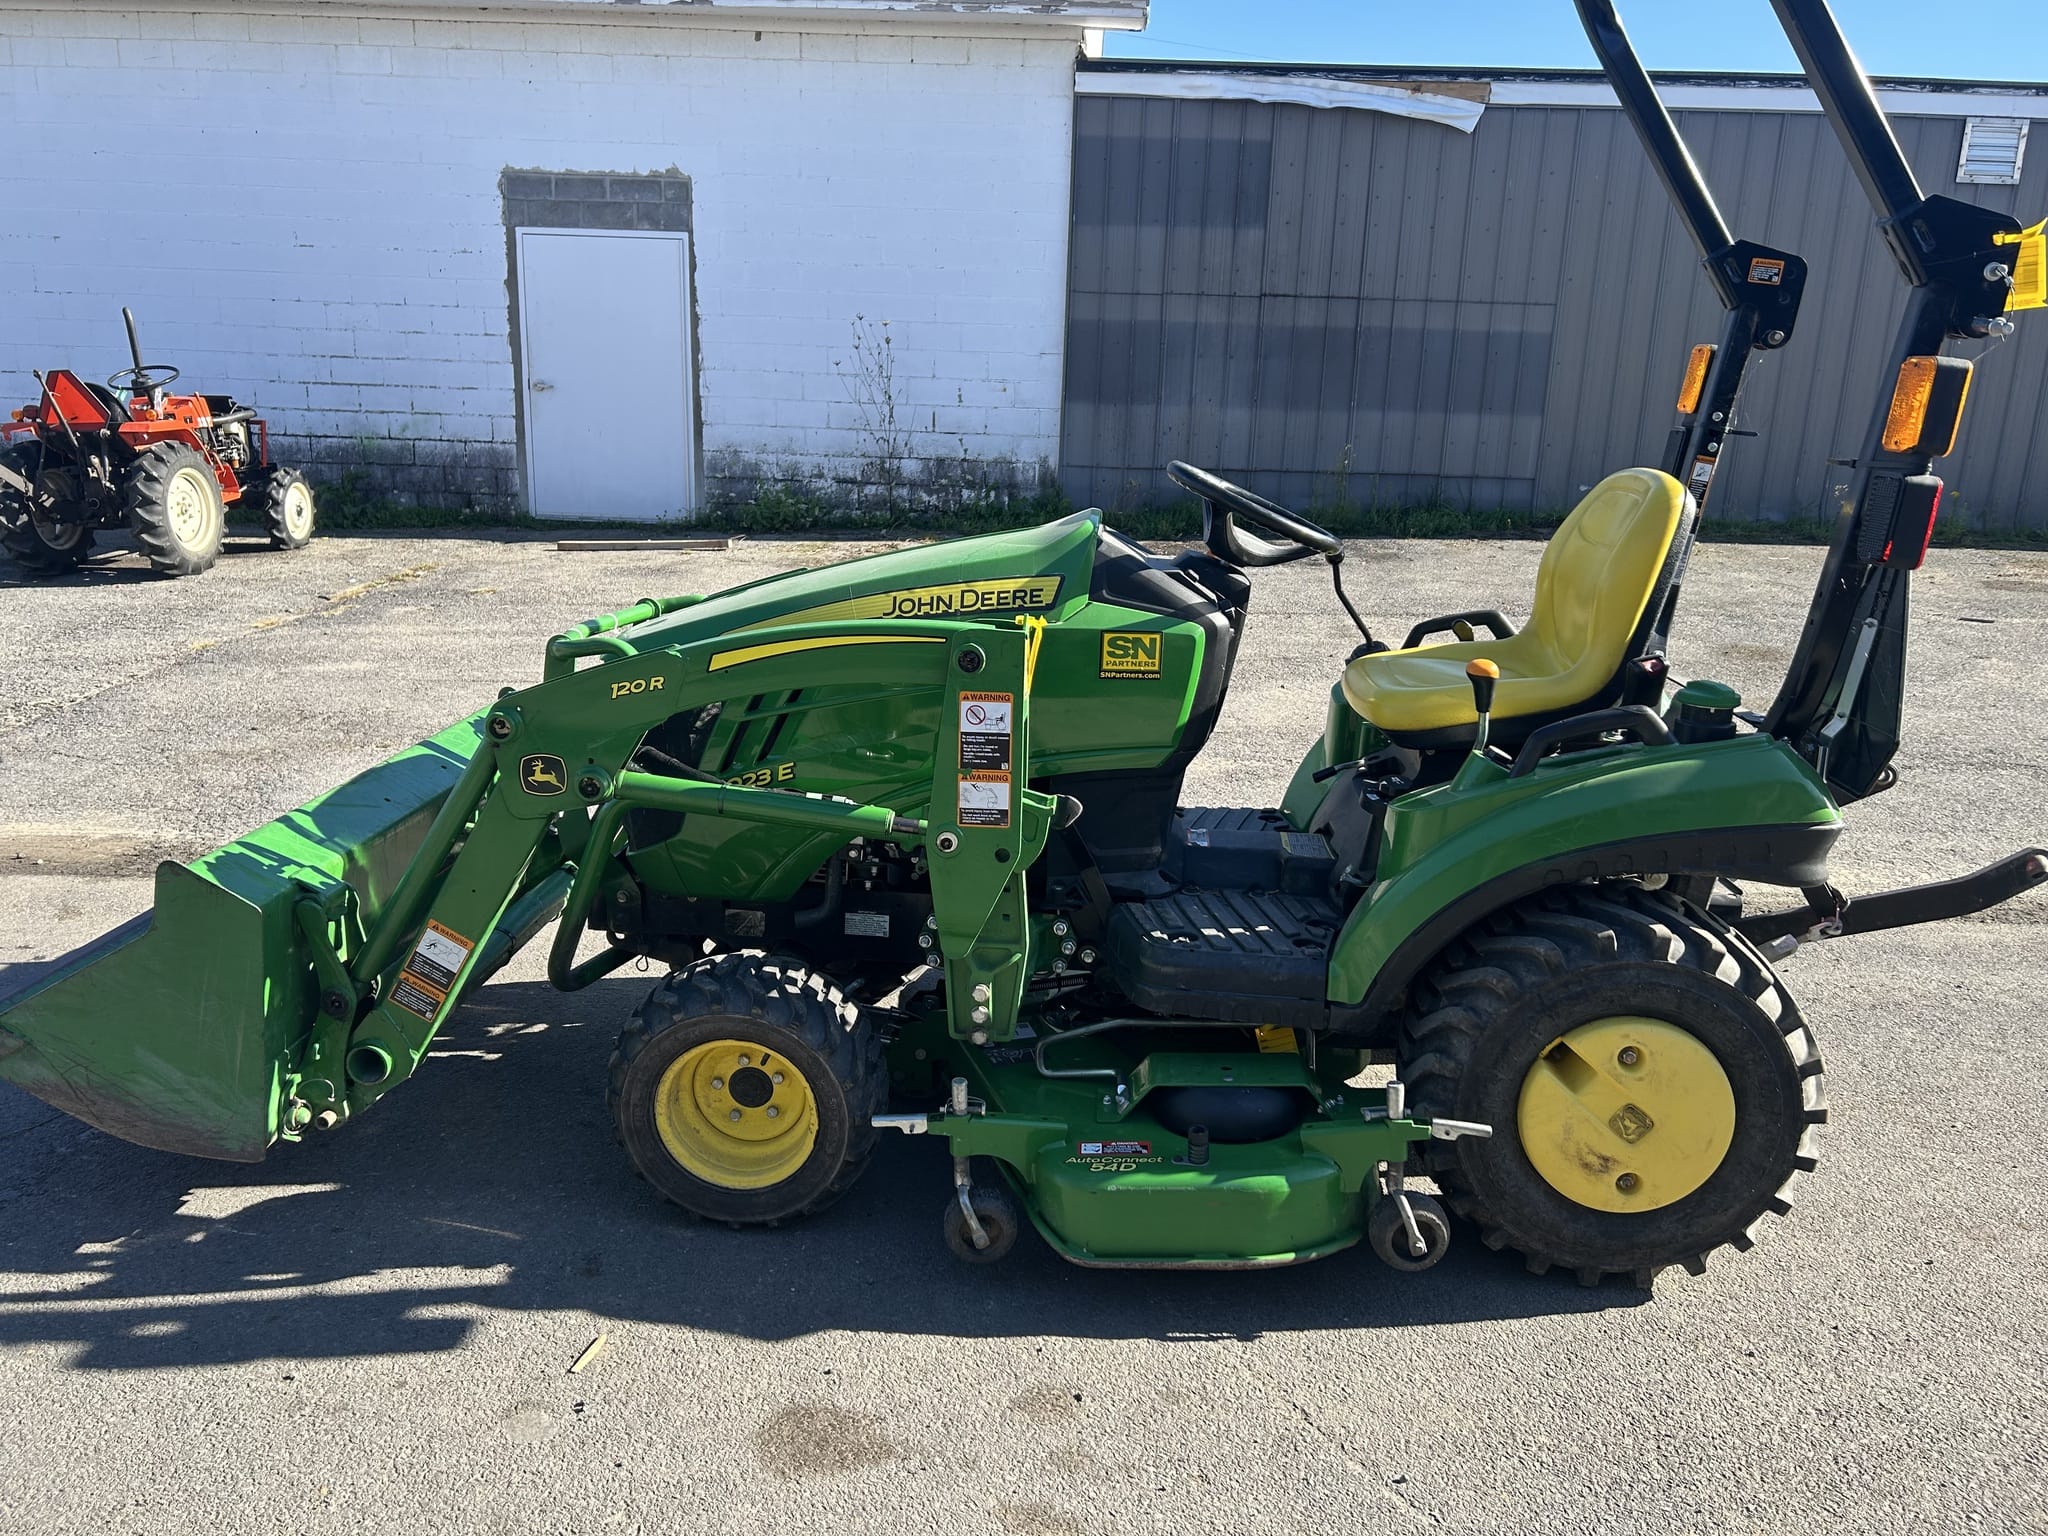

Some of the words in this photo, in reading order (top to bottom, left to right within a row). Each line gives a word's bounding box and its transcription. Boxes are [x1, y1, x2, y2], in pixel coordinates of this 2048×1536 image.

[882, 594, 953, 617] JOHN
[960, 588, 1044, 609] DEERE
[1105, 660, 1156, 668] PARTNERS
[1100, 671, 1160, 679] SNPartners.com
[611, 679, 647, 699] 120
[649, 676, 665, 691] R
[970, 693, 1010, 702] WARNING
[778, 761, 795, 781] E
[969, 773, 1009, 782] WARNING
[440, 927, 468, 947] WARNING
[411, 980, 440, 1000] WARNING
[1065, 1156, 1163, 1164] AutoConnect
[1090, 1163, 1137, 1172] 54D
